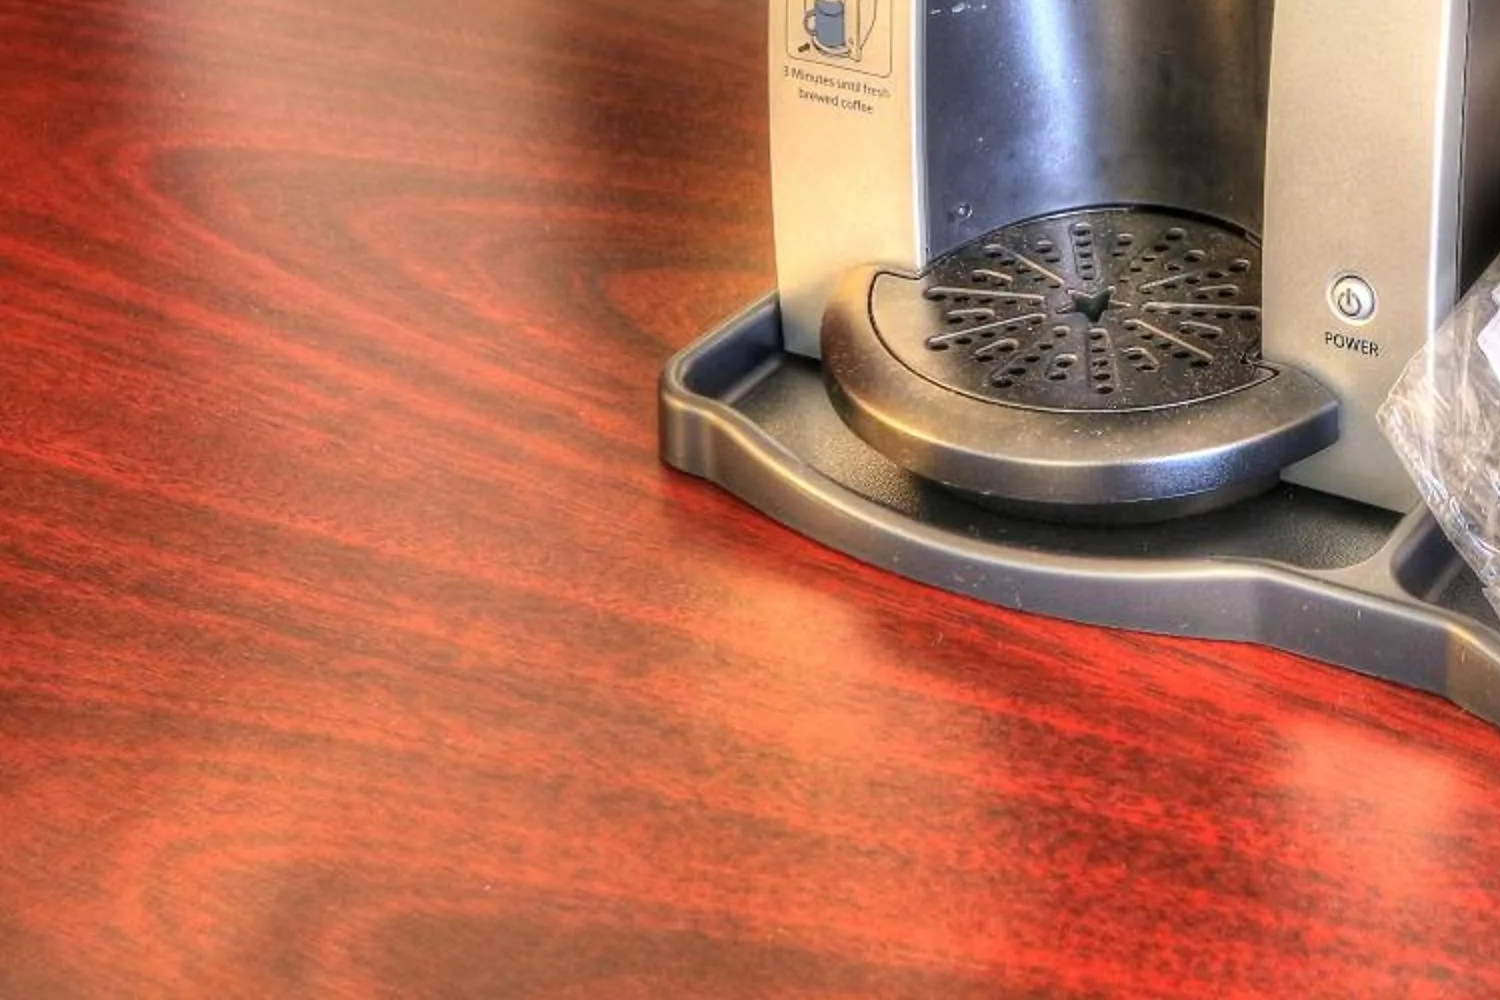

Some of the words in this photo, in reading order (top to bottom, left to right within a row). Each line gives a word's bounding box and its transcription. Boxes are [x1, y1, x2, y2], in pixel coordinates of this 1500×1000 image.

[784, 65, 789, 77] 3
[792, 67, 834, 87] Minutes
[837, 80, 861, 93] until
[799, 88, 838, 107] brewed
[841, 98, 874, 114] coffee
[1324, 331, 1379, 357] POWER
